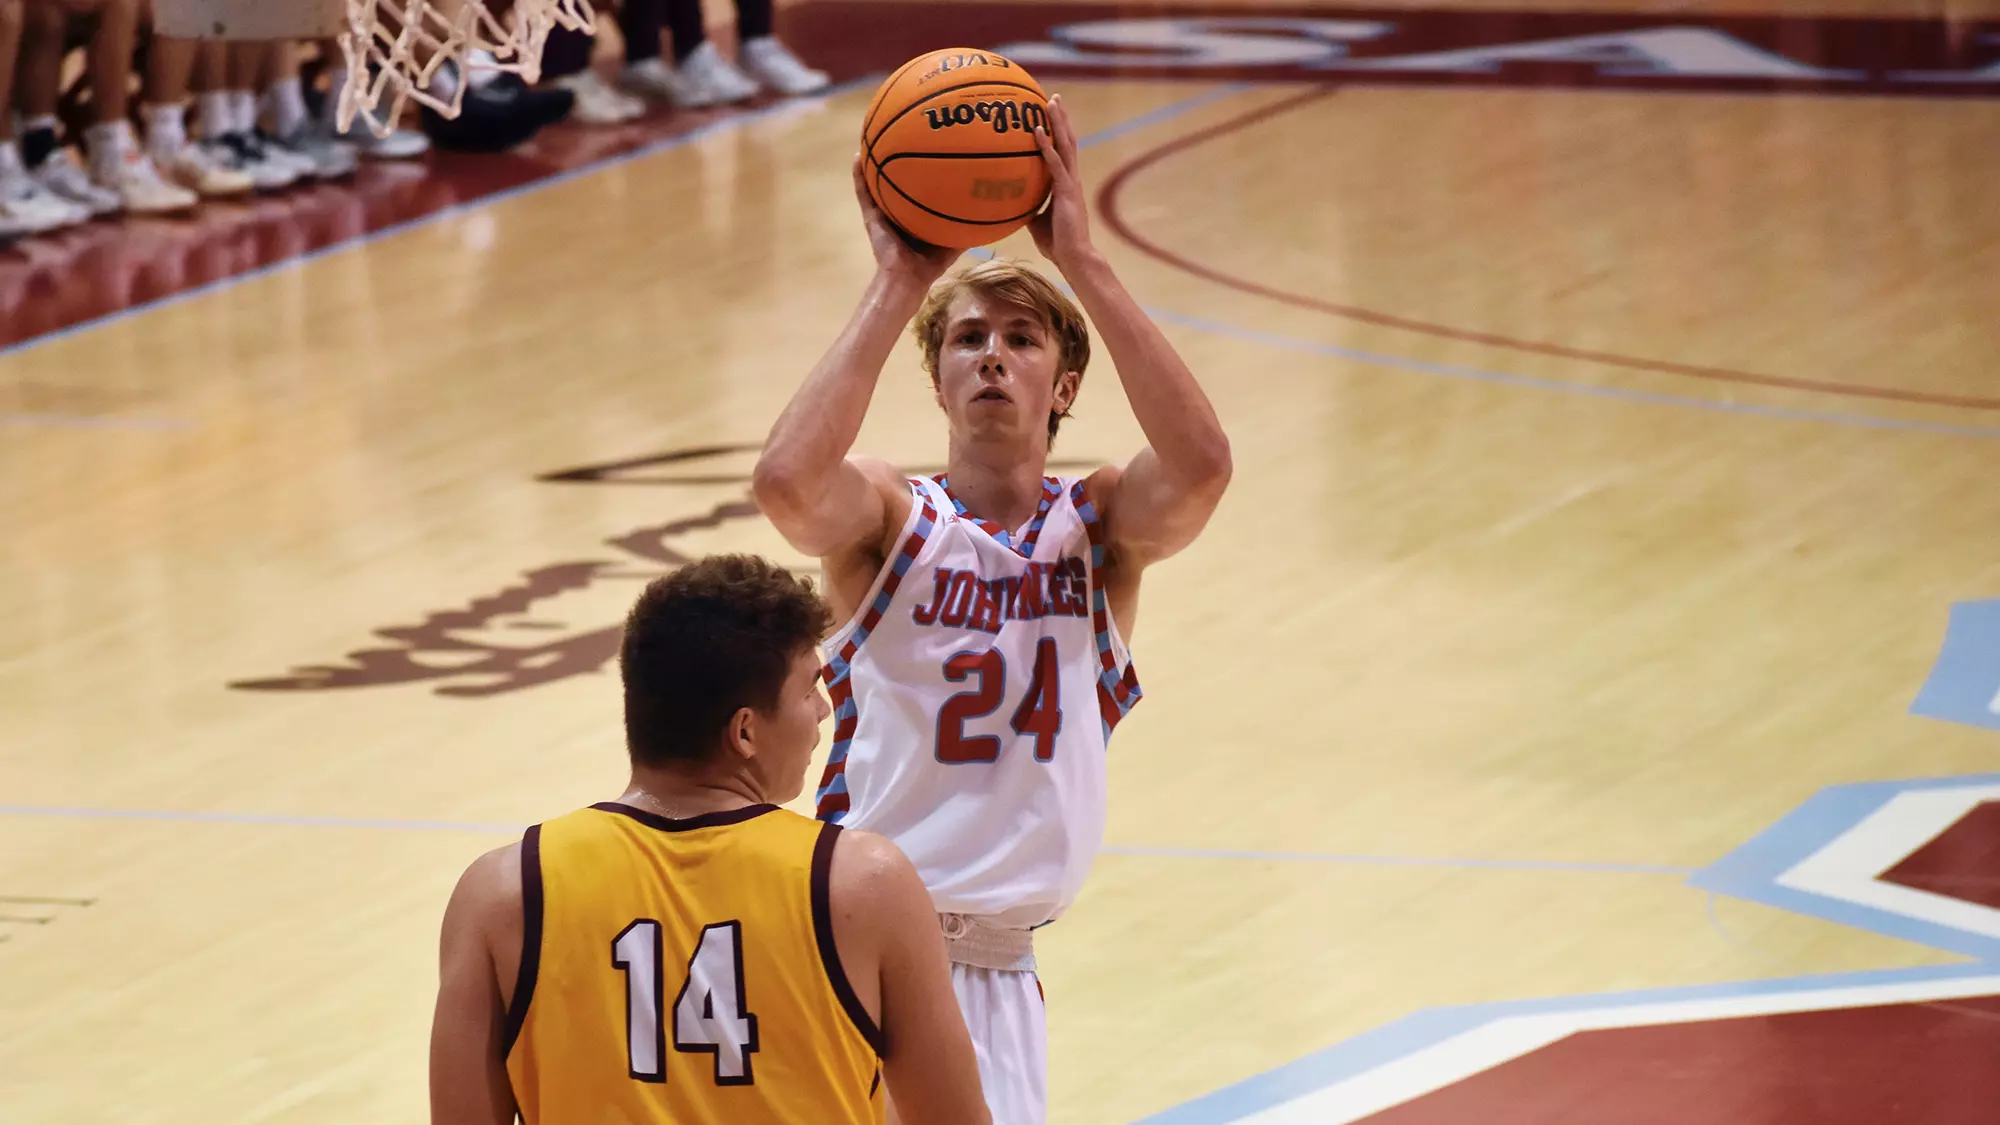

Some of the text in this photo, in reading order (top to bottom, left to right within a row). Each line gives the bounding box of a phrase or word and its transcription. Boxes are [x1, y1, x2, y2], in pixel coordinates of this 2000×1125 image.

[992, 16, 2000, 83] SA
[924, 99, 1052, 136] Wilson
[934, 635, 1063, 766] 24
[611, 917, 760, 1087] 14
